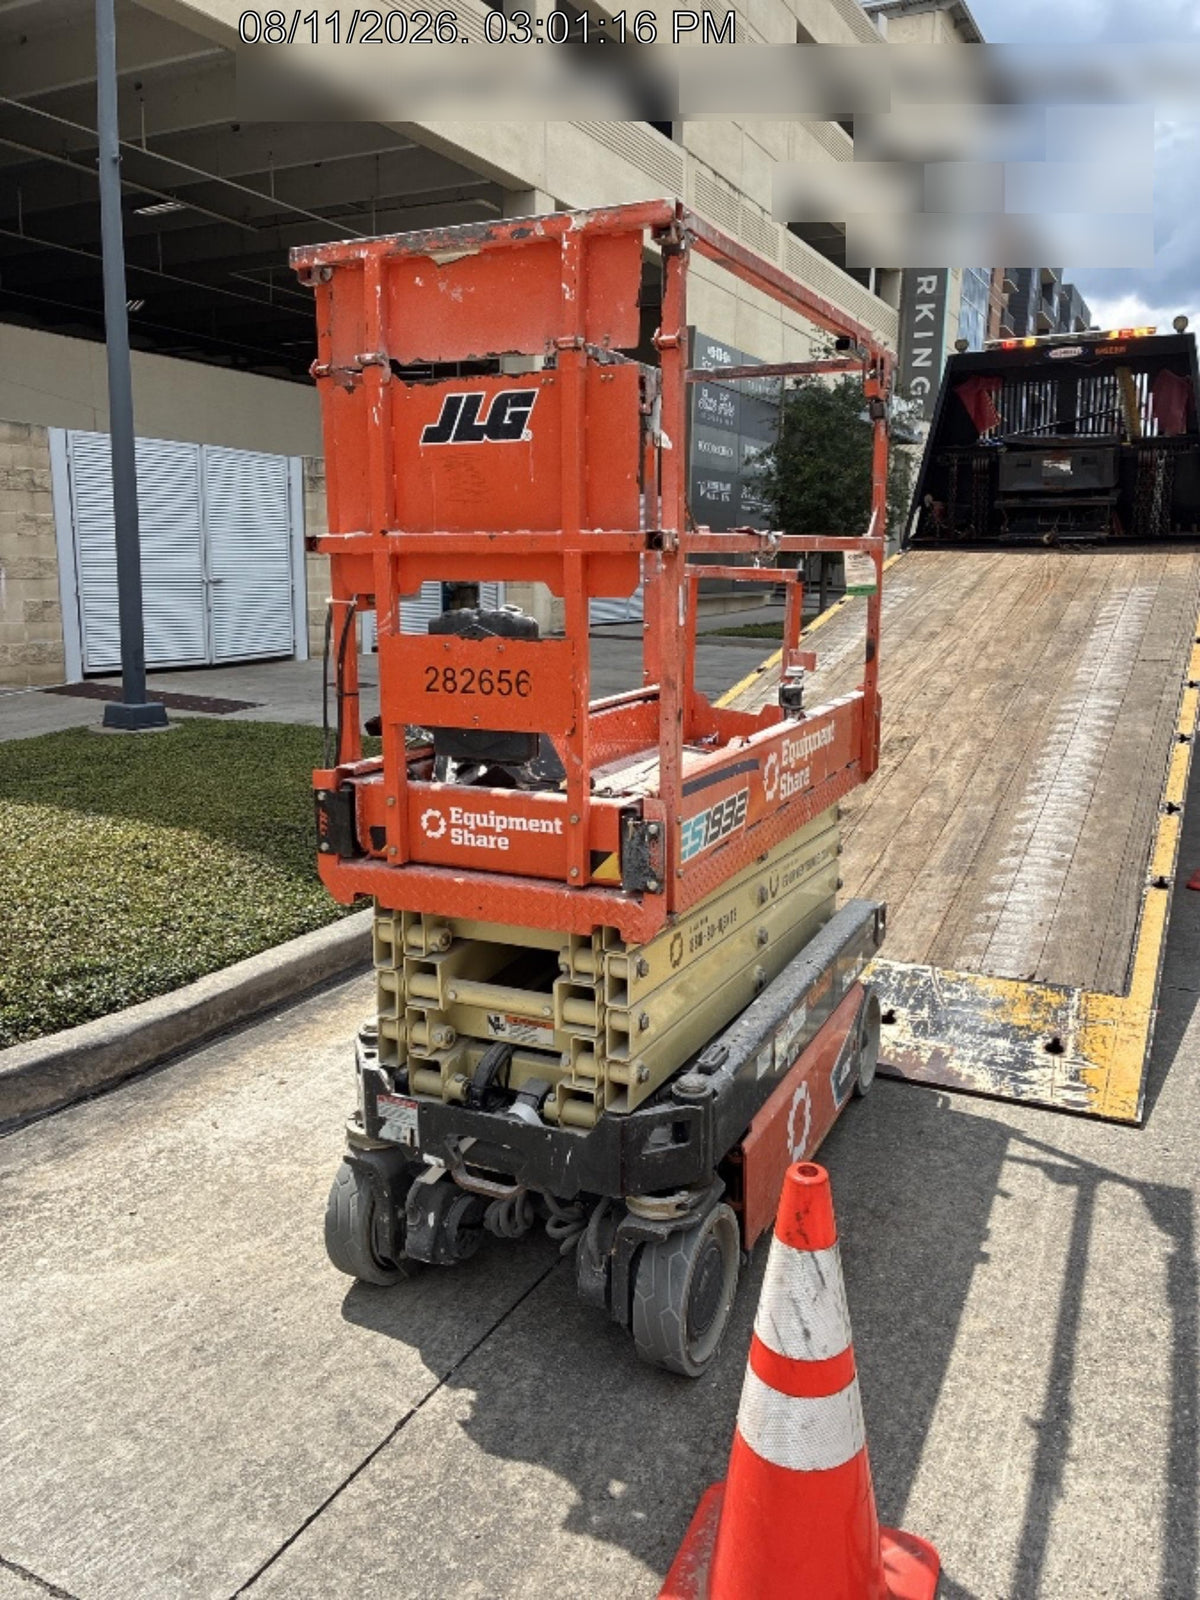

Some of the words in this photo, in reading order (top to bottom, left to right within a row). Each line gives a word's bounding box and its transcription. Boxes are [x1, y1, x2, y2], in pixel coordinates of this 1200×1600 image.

[420, 388, 539, 445] JLG
[425, 666, 532, 697] 282656
[781, 719, 835, 768] Equipment
[779, 766, 811, 800] Share
[449, 806, 564, 834] Equipment
[681, 787, 749, 864] ES1932
[450, 828, 510, 851] Share
